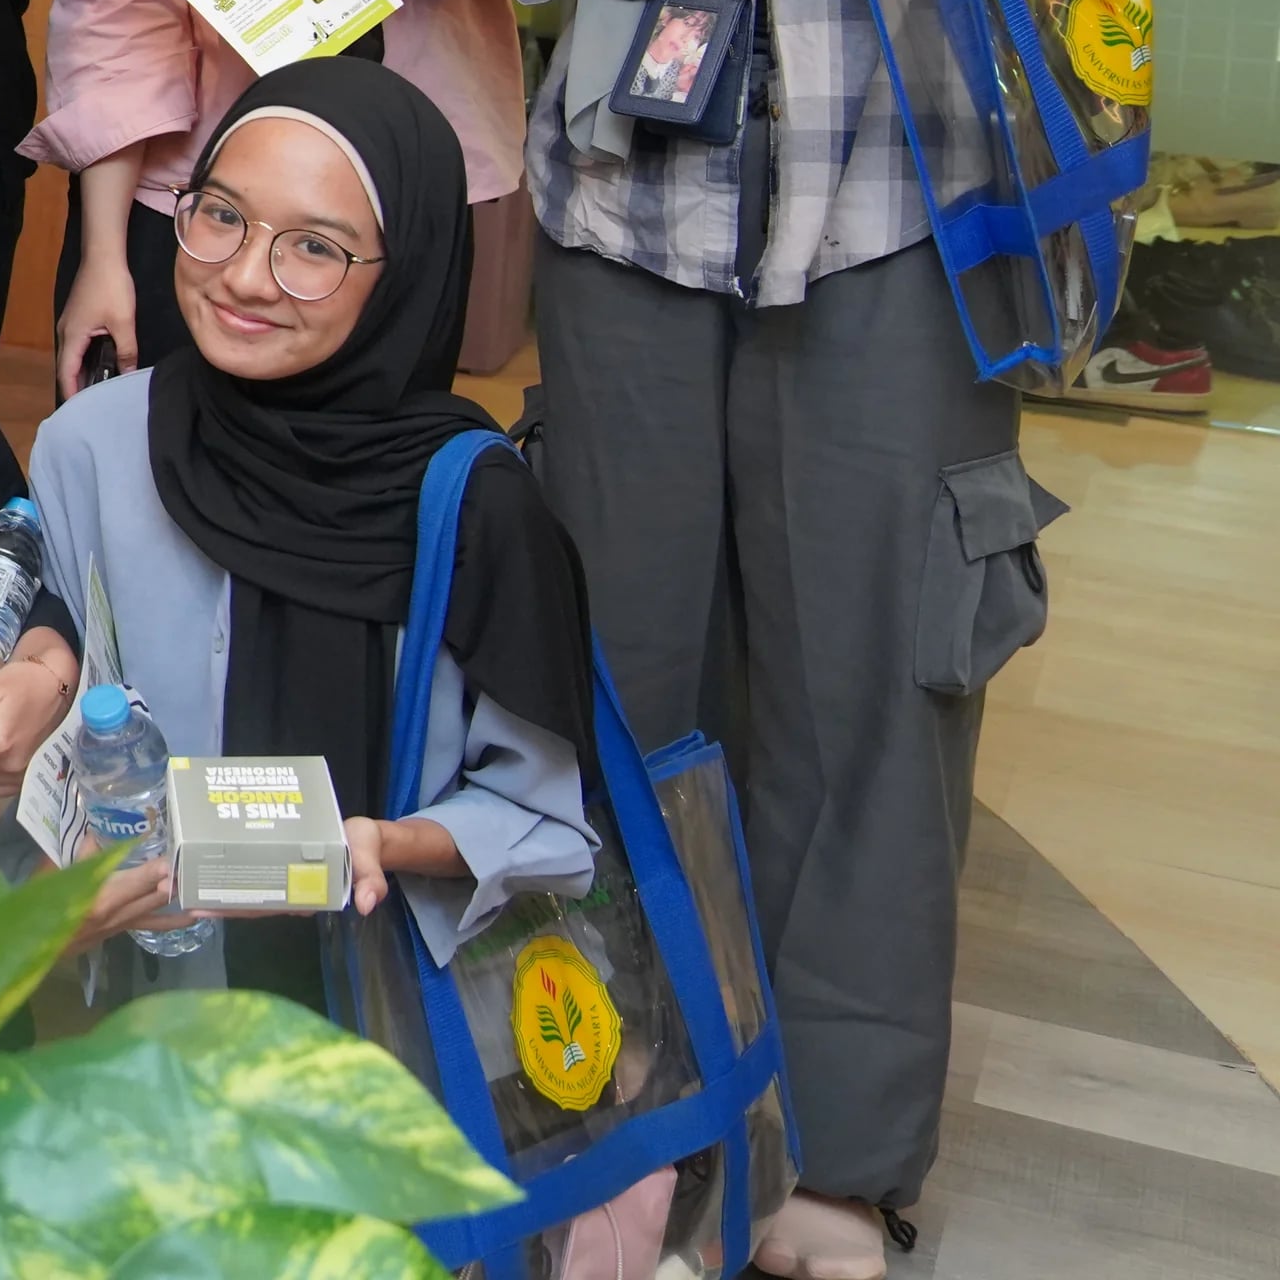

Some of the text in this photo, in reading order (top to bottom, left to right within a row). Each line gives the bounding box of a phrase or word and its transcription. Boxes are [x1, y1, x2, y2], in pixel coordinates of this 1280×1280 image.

[1082, 43, 1142, 89] UNIVERSITAS
[205, 766, 295, 776] INDONESIA
[204, 775, 299, 785] BURGERNYA
[207, 791, 304, 804] BANGOR
[216, 803, 301, 819] THIS IS
[529, 1037, 578, 1091] UNIVERSITAS
[590, 1004, 601, 1062] JAKARTA
